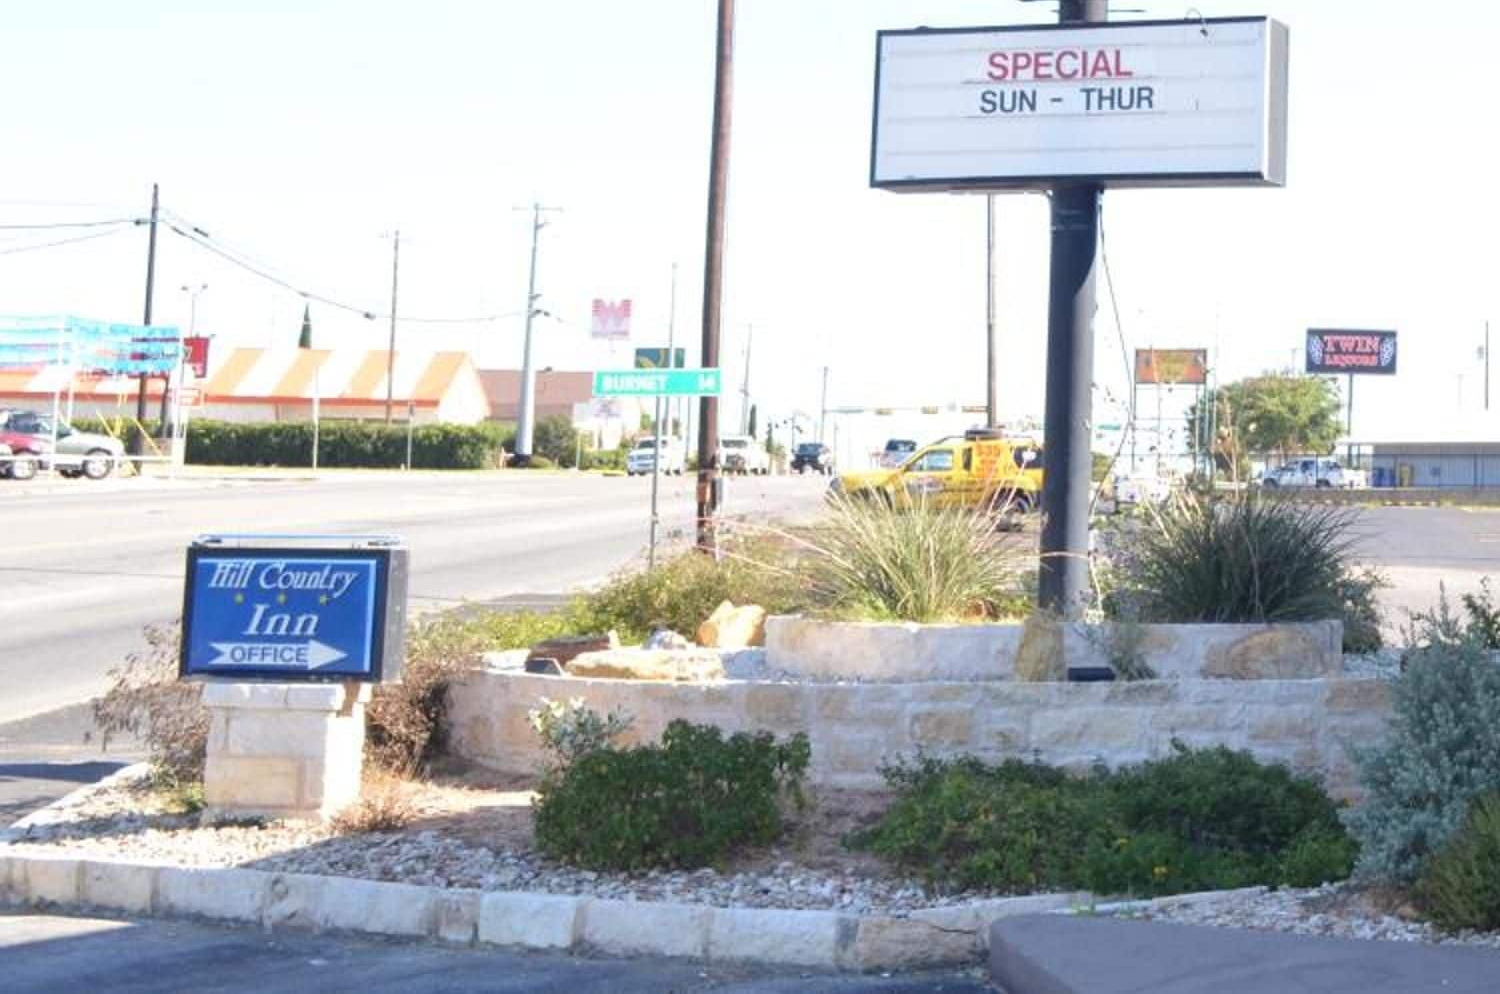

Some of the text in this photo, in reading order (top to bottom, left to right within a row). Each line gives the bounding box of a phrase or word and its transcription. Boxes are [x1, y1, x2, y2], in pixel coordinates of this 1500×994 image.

[987, 50, 1133, 80] SPECIAL
[980, 91, 1037, 114] SUN
[1080, 87, 1154, 111] THUR
[1323, 335, 1380, 352] TWIN
[208, 561, 357, 598] Hill Country
[243, 604, 318, 636] Inn
[230, 646, 308, 663] OFFICE
